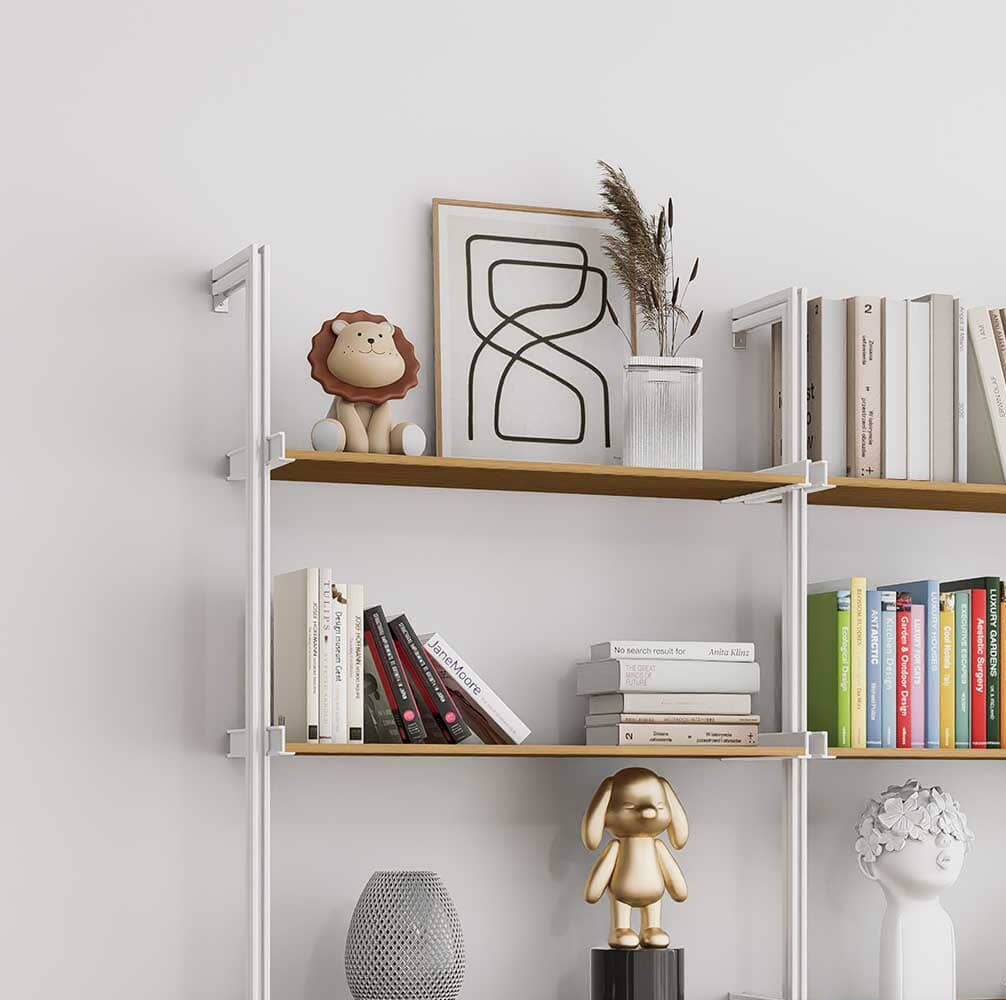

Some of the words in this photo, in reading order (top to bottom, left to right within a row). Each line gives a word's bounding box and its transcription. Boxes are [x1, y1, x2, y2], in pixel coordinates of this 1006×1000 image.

[863, 303, 873, 314] 2
[322, 580, 330, 631] TULIPS
[930, 591, 939, 630] LUXURY
[989, 588, 998, 628] LUXURY
[334, 611, 343, 636] Design
[870, 609, 880, 665] ANTARCTIC
[885, 617, 895, 656] Kitchen
[900, 615, 910, 645] Garden
[943, 625, 952, 643] Cool
[960, 603, 968, 648] EXECUTIVE
[335, 635, 343, 664] museum
[614, 646, 625, 655] No
[626, 646, 651, 656] search
[652, 647, 674, 656] result
[675, 647, 687, 656] for
[708, 647, 729, 656] Anita
[730, 648, 750, 657] Klinz
[839, 626, 849, 664] Ecological
[900, 646, 910, 654] &
[943, 645, 952, 669] Hotels
[989, 629, 998, 678] GARDENS
[625, 664, 637, 672] THE
[637, 664, 656, 672] GREAT
[839, 666, 849, 692] Design
[884, 657, 895, 691] Design
[900, 655, 910, 688] Outdoor
[960, 648, 968, 685] ESCAPES
[974, 656, 985, 694] Surgery
[625, 679, 648, 687] FUTURE
[898, 690, 910, 718] Design
[625, 732, 634, 740] 2
